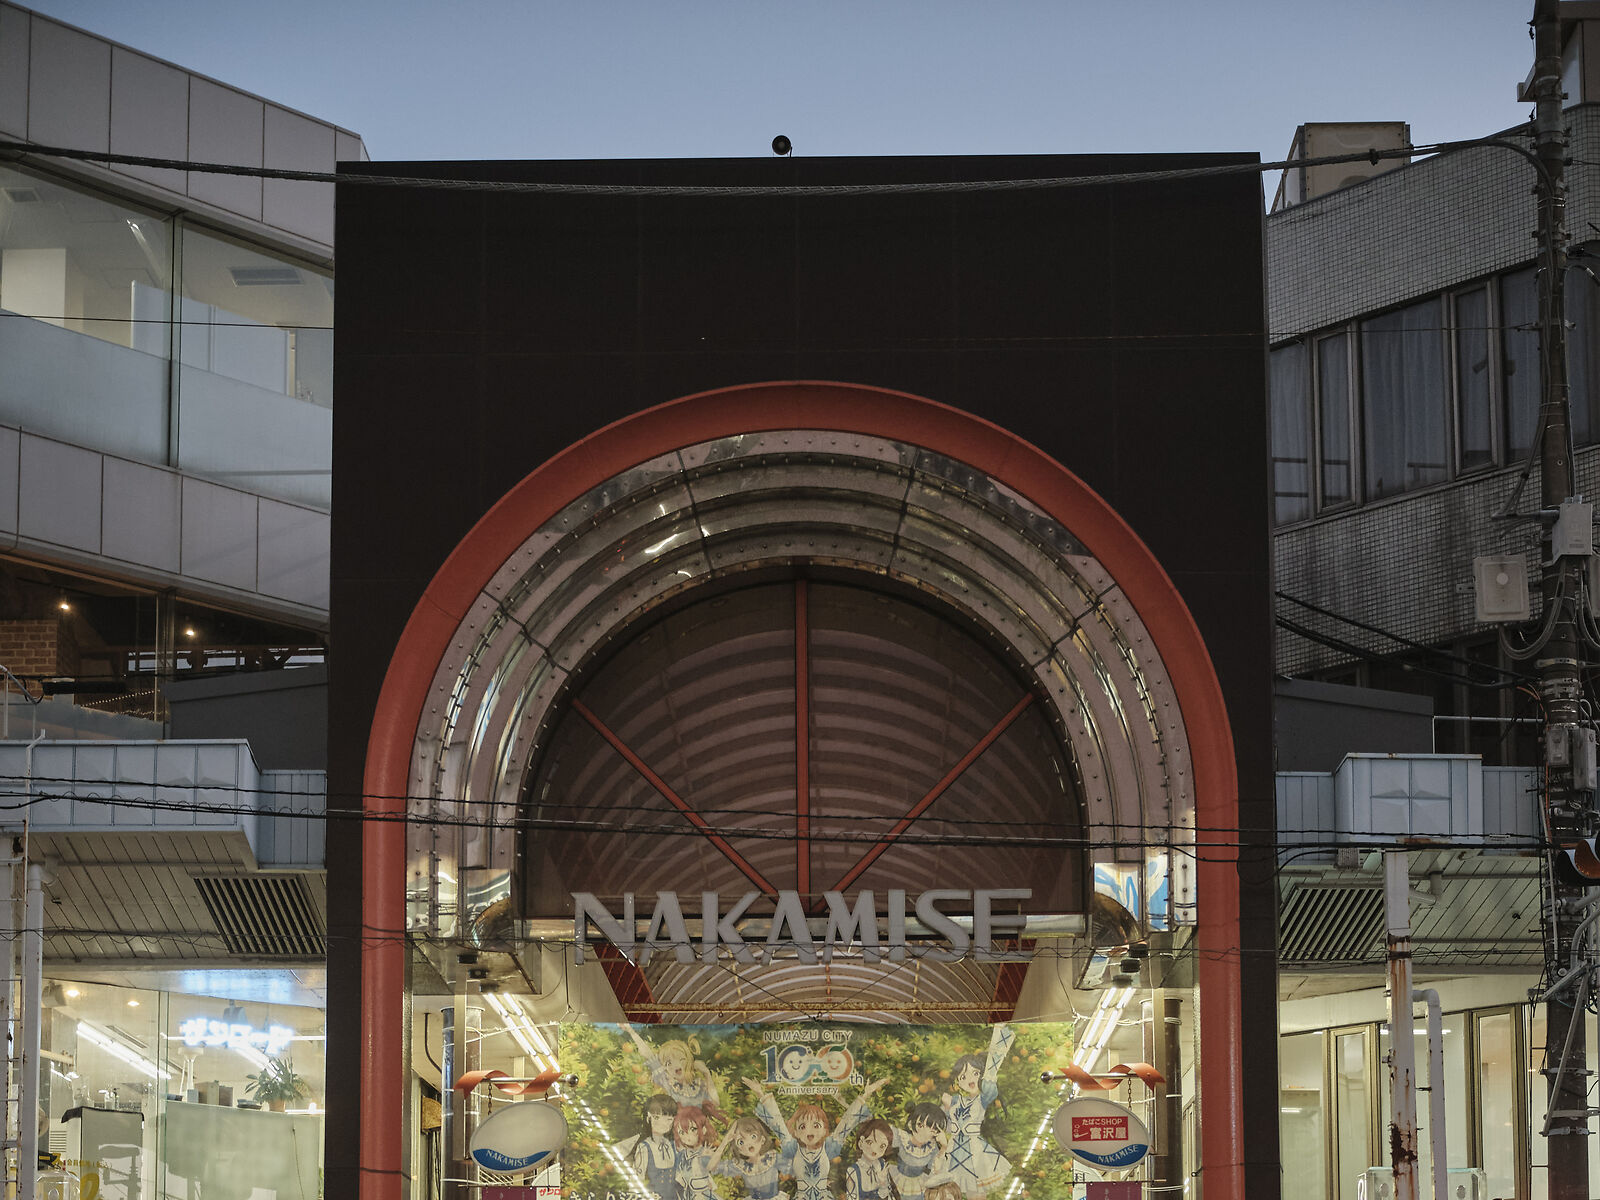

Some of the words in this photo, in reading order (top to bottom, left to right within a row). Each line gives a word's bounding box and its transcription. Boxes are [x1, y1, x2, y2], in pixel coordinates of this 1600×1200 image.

[570, 888, 1033, 966] NAKAMISE
[763, 1030, 820, 1041] NUMAZU
[822, 1030, 853, 1041] CITY
[778, 1086, 838, 1097] Anniversary
[1082, 1118, 1123, 1126] たばこSHOP
[1090, 1127, 1127, 1140] 富沢屋
[486, 1149, 528, 1168] NAKAMISE
[1097, 1144, 1139, 1163] NAKAMISE
